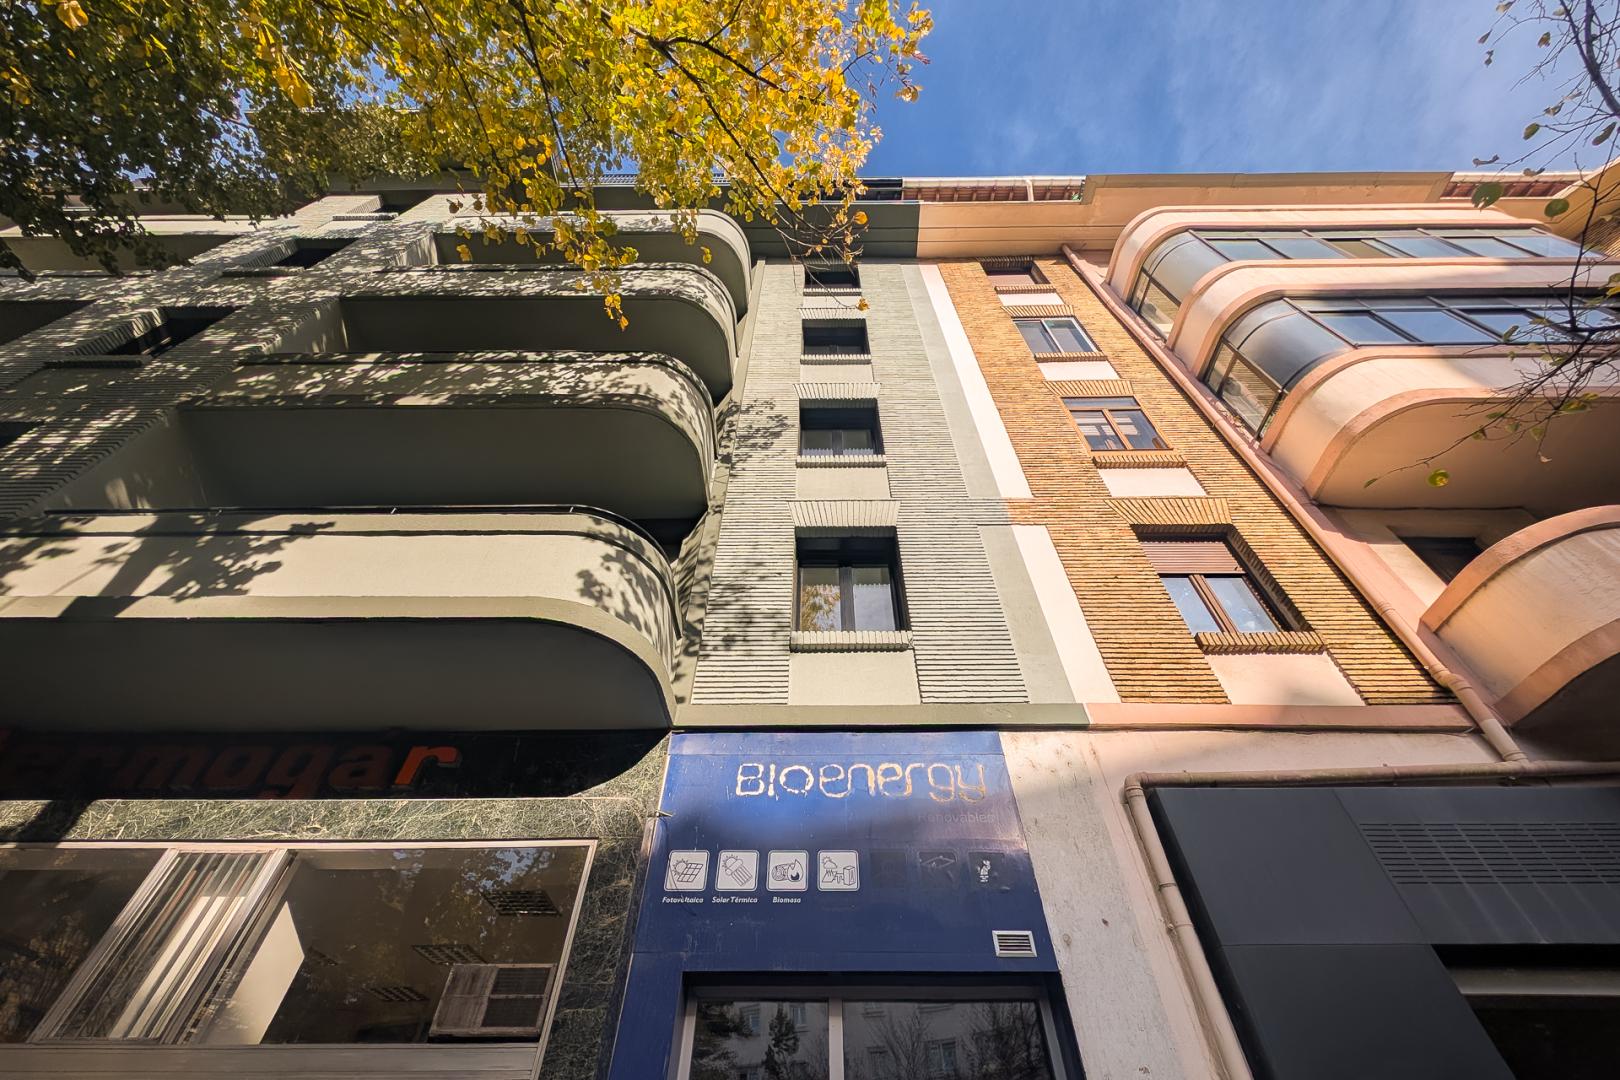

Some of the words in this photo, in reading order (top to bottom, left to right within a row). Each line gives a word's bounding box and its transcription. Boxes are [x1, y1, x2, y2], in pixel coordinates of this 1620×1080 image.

[0, 728, 462, 799] ermogar
[735, 762, 986, 803] Bioenergy
[712, 896, 730, 904] Solar
[731, 896, 758, 904] Térmica
[772, 896, 802, 904] Biomasa
